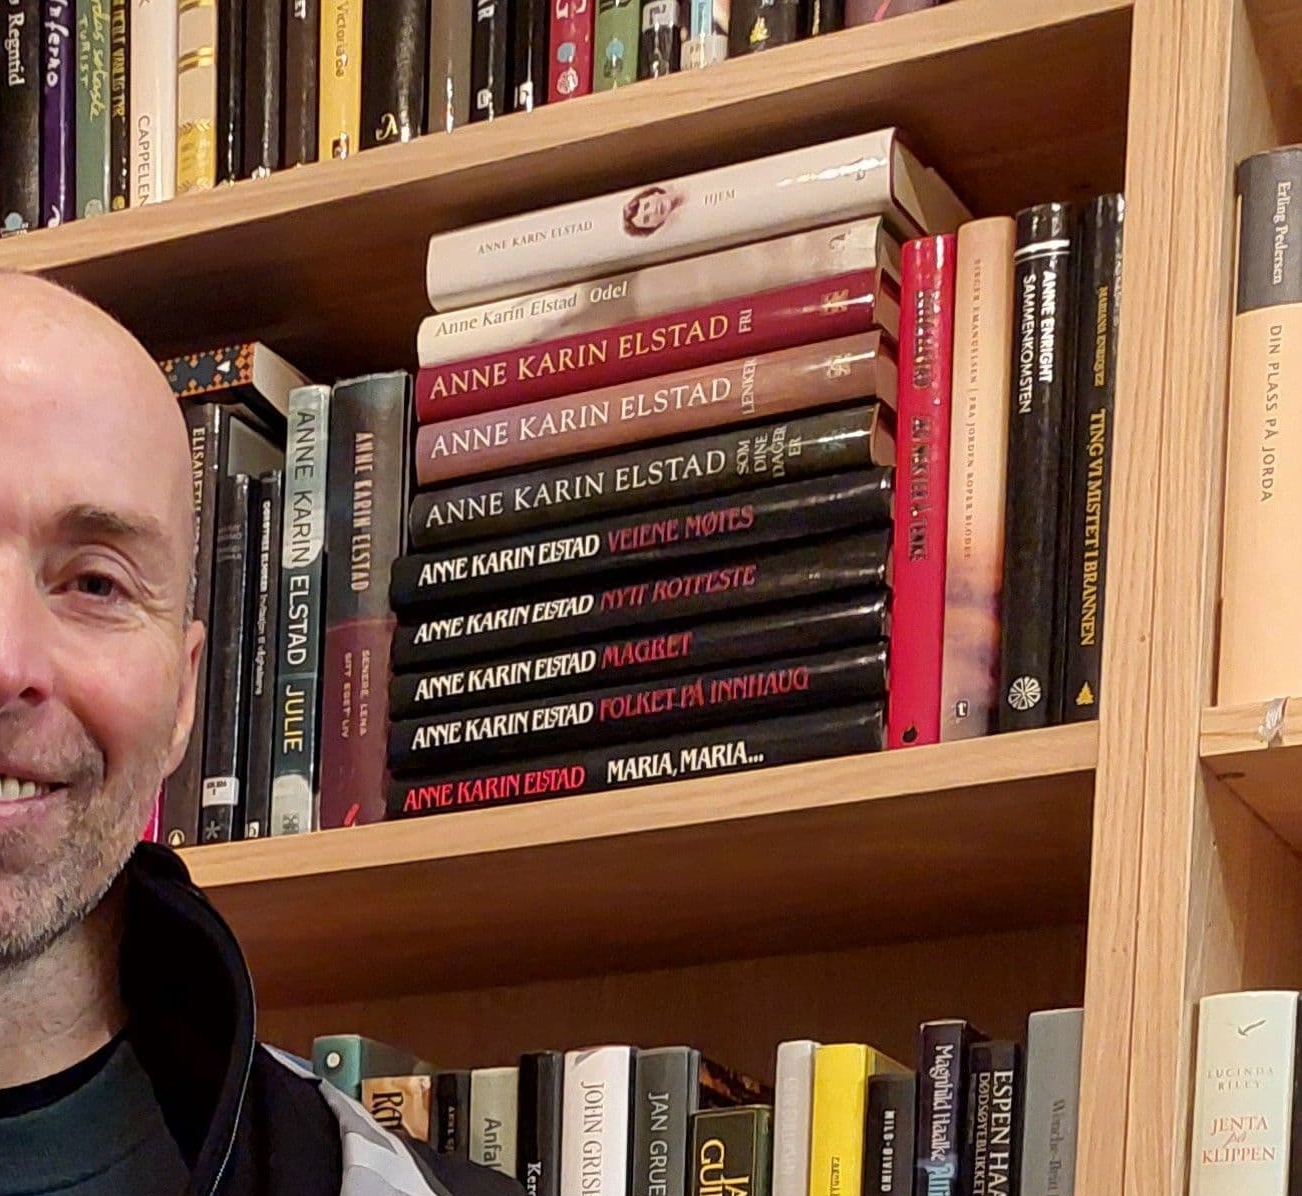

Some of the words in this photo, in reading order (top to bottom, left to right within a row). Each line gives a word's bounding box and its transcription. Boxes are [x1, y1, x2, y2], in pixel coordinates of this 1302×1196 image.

[4, 13, 26, 87] Regntid
[137, 114, 152, 207] CAPPELEN
[477, 239, 509, 255] ANNE
[511, 230, 549, 248] KARIN
[550, 219, 594, 243] ELSTAD
[703, 189, 736, 207] HJEM
[1274, 180, 1292, 227] Erling
[1272, 226, 1288, 285] Pedersen
[435, 316, 479, 337] Anne
[481, 306, 526, 330] Karin
[530, 293, 578, 317] Elstad
[588, 280, 629, 304] Odel
[1040, 270, 1057, 311] ANNE
[430, 362, 508, 400] ANNE
[516, 337, 609, 382] KARIN
[616, 313, 729, 360] ELSTAD
[737, 308, 754, 333] FRI
[1018, 274, 1037, 415] SAMMENKOMSTEN
[1037, 311, 1055, 386] ENRIGHT
[1268, 323, 1284, 355] DIN
[1265, 357, 1281, 413] PLASS
[292, 410, 317, 481] ANNE
[354, 431, 375, 475] ANNE
[1264, 416, 1279, 444] PÅ
[352, 477, 373, 531] KARIN
[425, 493, 505, 530] ANNE
[513, 471, 604, 512] KARIN
[614, 449, 727, 493] ELSTAD
[1260, 444, 1276, 504] JORDA
[290, 491, 314, 569] KARIN
[351, 532, 371, 594] ELSTAD
[286, 574, 310, 668] ELSTAD
[283, 682, 305, 755] JULIE
[403, 783, 454, 813] ANNE
[456, 771, 521, 805] KARIN
[523, 765, 586, 794] ELSTAD
[606, 752, 678, 785] MARIA,
[679, 740, 765, 775] MARIA...
[1207, 1063, 1277, 1081] LUCINDA
[1217, 1078, 1263, 1092] RILEY
[649, 1092, 670, 1132] JAN
[972, 1071, 991, 1196] DØDSØYEBLIKKET
[992, 1069, 1014, 1145] ESPEN
[1210, 1114, 1271, 1134] JENTA
[1201, 1145, 1278, 1165] KLIPPEN
